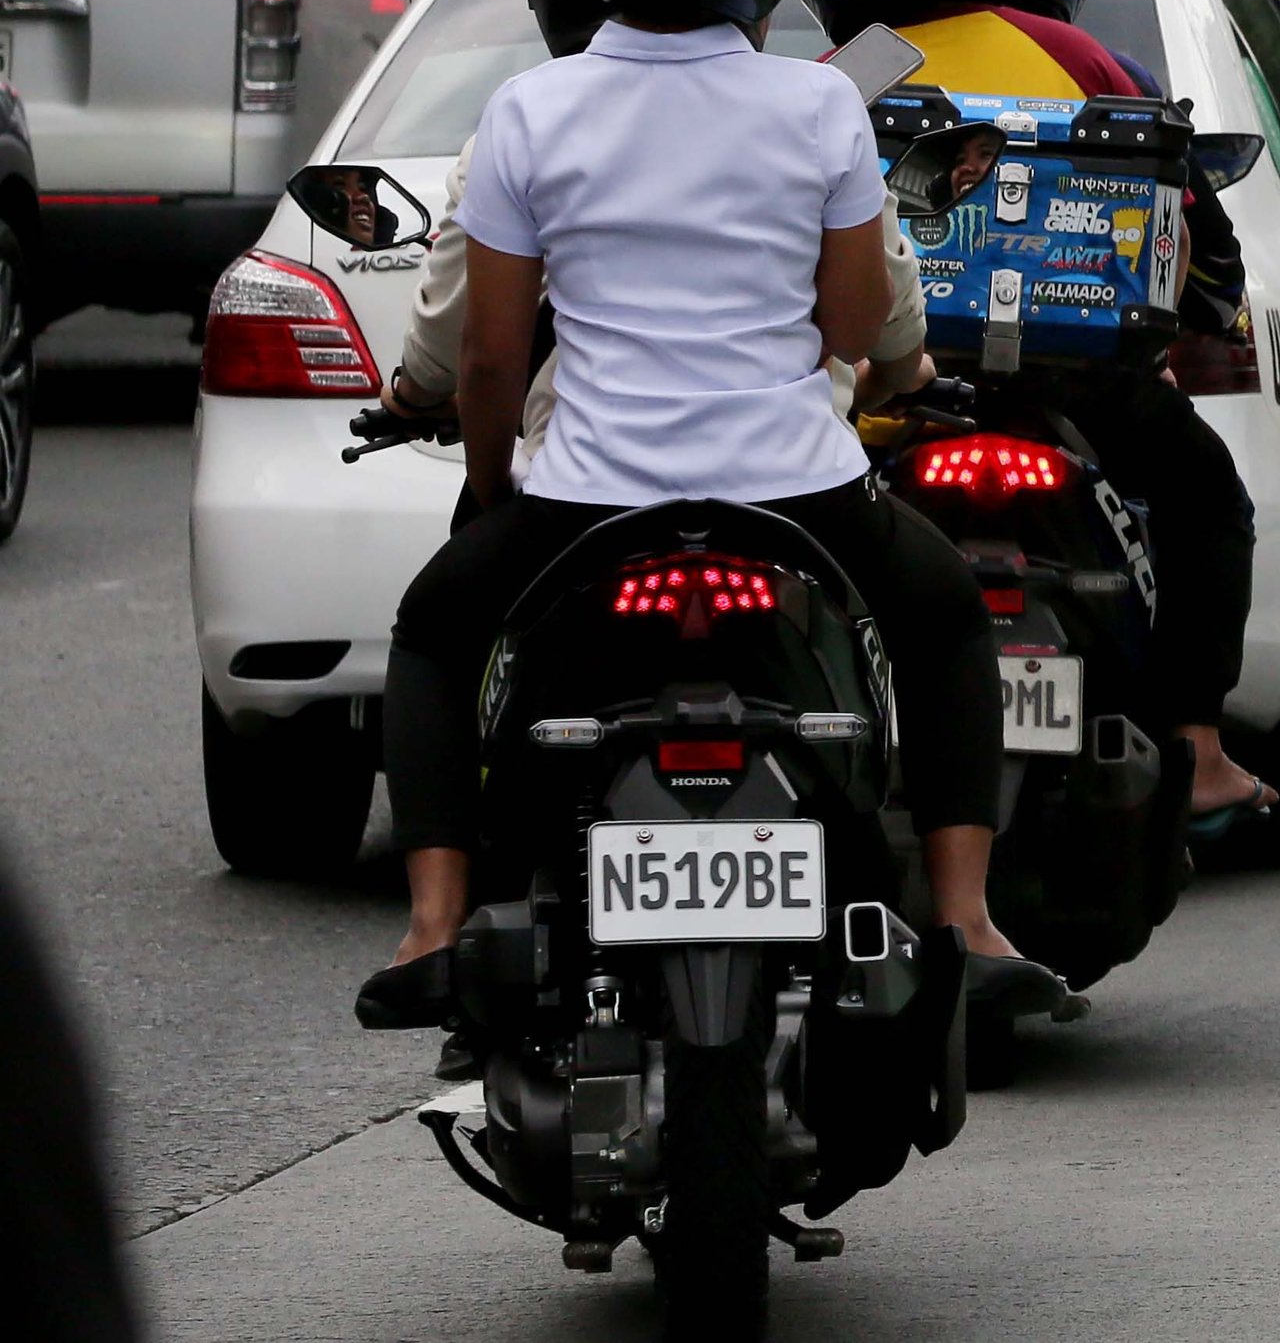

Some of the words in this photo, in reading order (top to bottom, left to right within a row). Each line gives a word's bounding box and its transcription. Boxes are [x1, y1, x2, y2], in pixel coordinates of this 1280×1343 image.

[1070, 176, 1152, 197] MONSTER
[1049, 198, 1104, 218] DAILY
[1044, 215, 1111, 235] GRIND
[920, 232, 941, 241] CUP
[336, 252, 425, 274] VIOS
[919, 257, 965, 272] NSTER
[920, 270, 958, 278] ERGY
[1033, 282, 1116, 301] KALMADO
[670, 776, 732, 787] HONDA
[602, 850, 811, 912] N519BE
